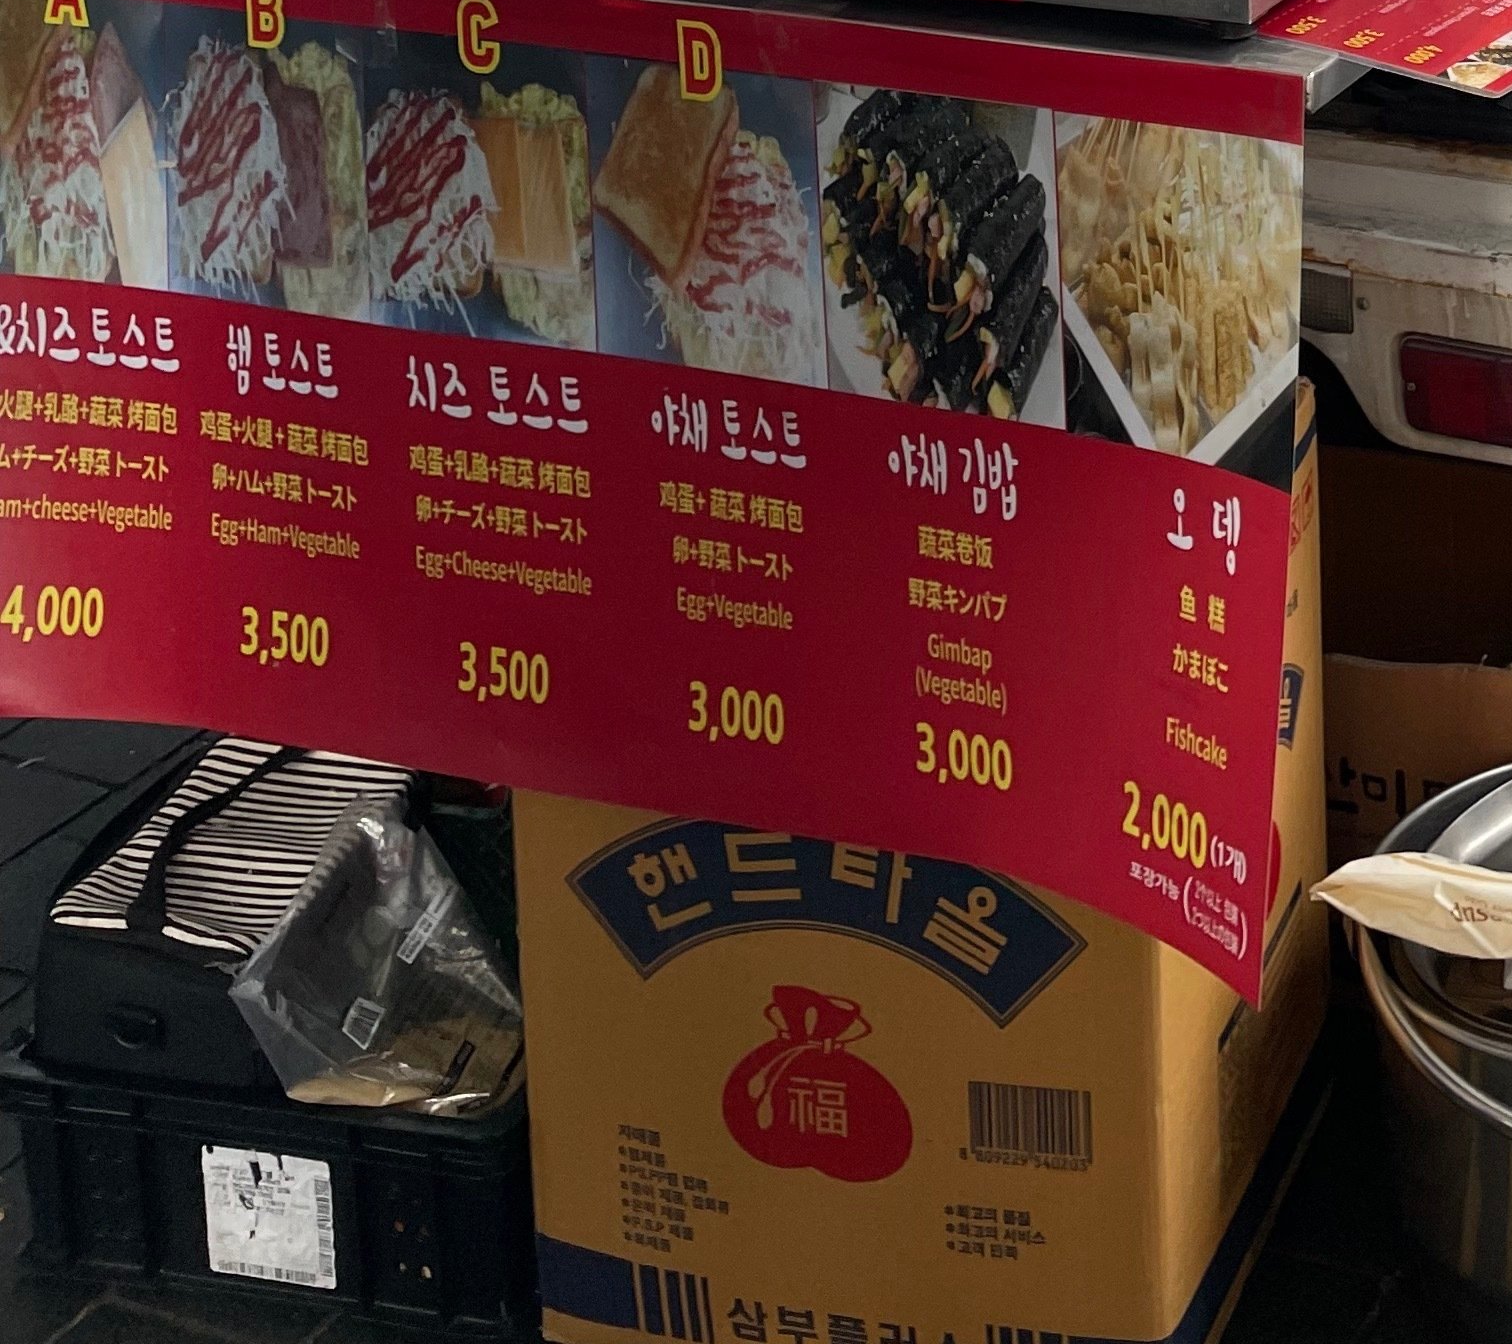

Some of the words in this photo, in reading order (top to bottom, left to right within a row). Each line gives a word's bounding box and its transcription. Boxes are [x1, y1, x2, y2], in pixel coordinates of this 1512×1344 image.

[676, 18, 722, 102] D
[87, 308, 180, 373] 토스트
[226, 324, 251, 395] 햄
[262, 332, 339, 399] 토스트
[407, 355, 472, 419] 치즈
[487, 365, 589, 434] 토스트
[651, 393, 708, 453] 야채
[720, 399, 807, 469] 토스트
[888, 433, 948, 495] 야채
[958, 437, 1019, 521] 김밥
[211, 512, 361, 560] Egg+Ham+Vegetable
[415, 545, 592, 596] Egg+Cheese+Vegetable
[0, 584, 104, 643] 4,000
[240, 606, 330, 667] 3,500
[676, 587, 794, 631] Egg+Vegetable
[457, 641, 549, 704] 3,500
[926, 633, 993, 675] Gimbap
[1172, 642, 1230, 694] かまぼこ
[688, 680, 785, 745] 3,000
[914, 665, 1007, 716] (Vegetable)
[914, 722, 1014, 792] 3,000
[1165, 716, 1229, 771] Fishcake
[1121, 780, 1208, 870] 2,000
[1209, 834, 1248, 887] (1개)
[1128, 860, 1181, 902] 포장가능
[787, 1076, 849, 1138] 福
